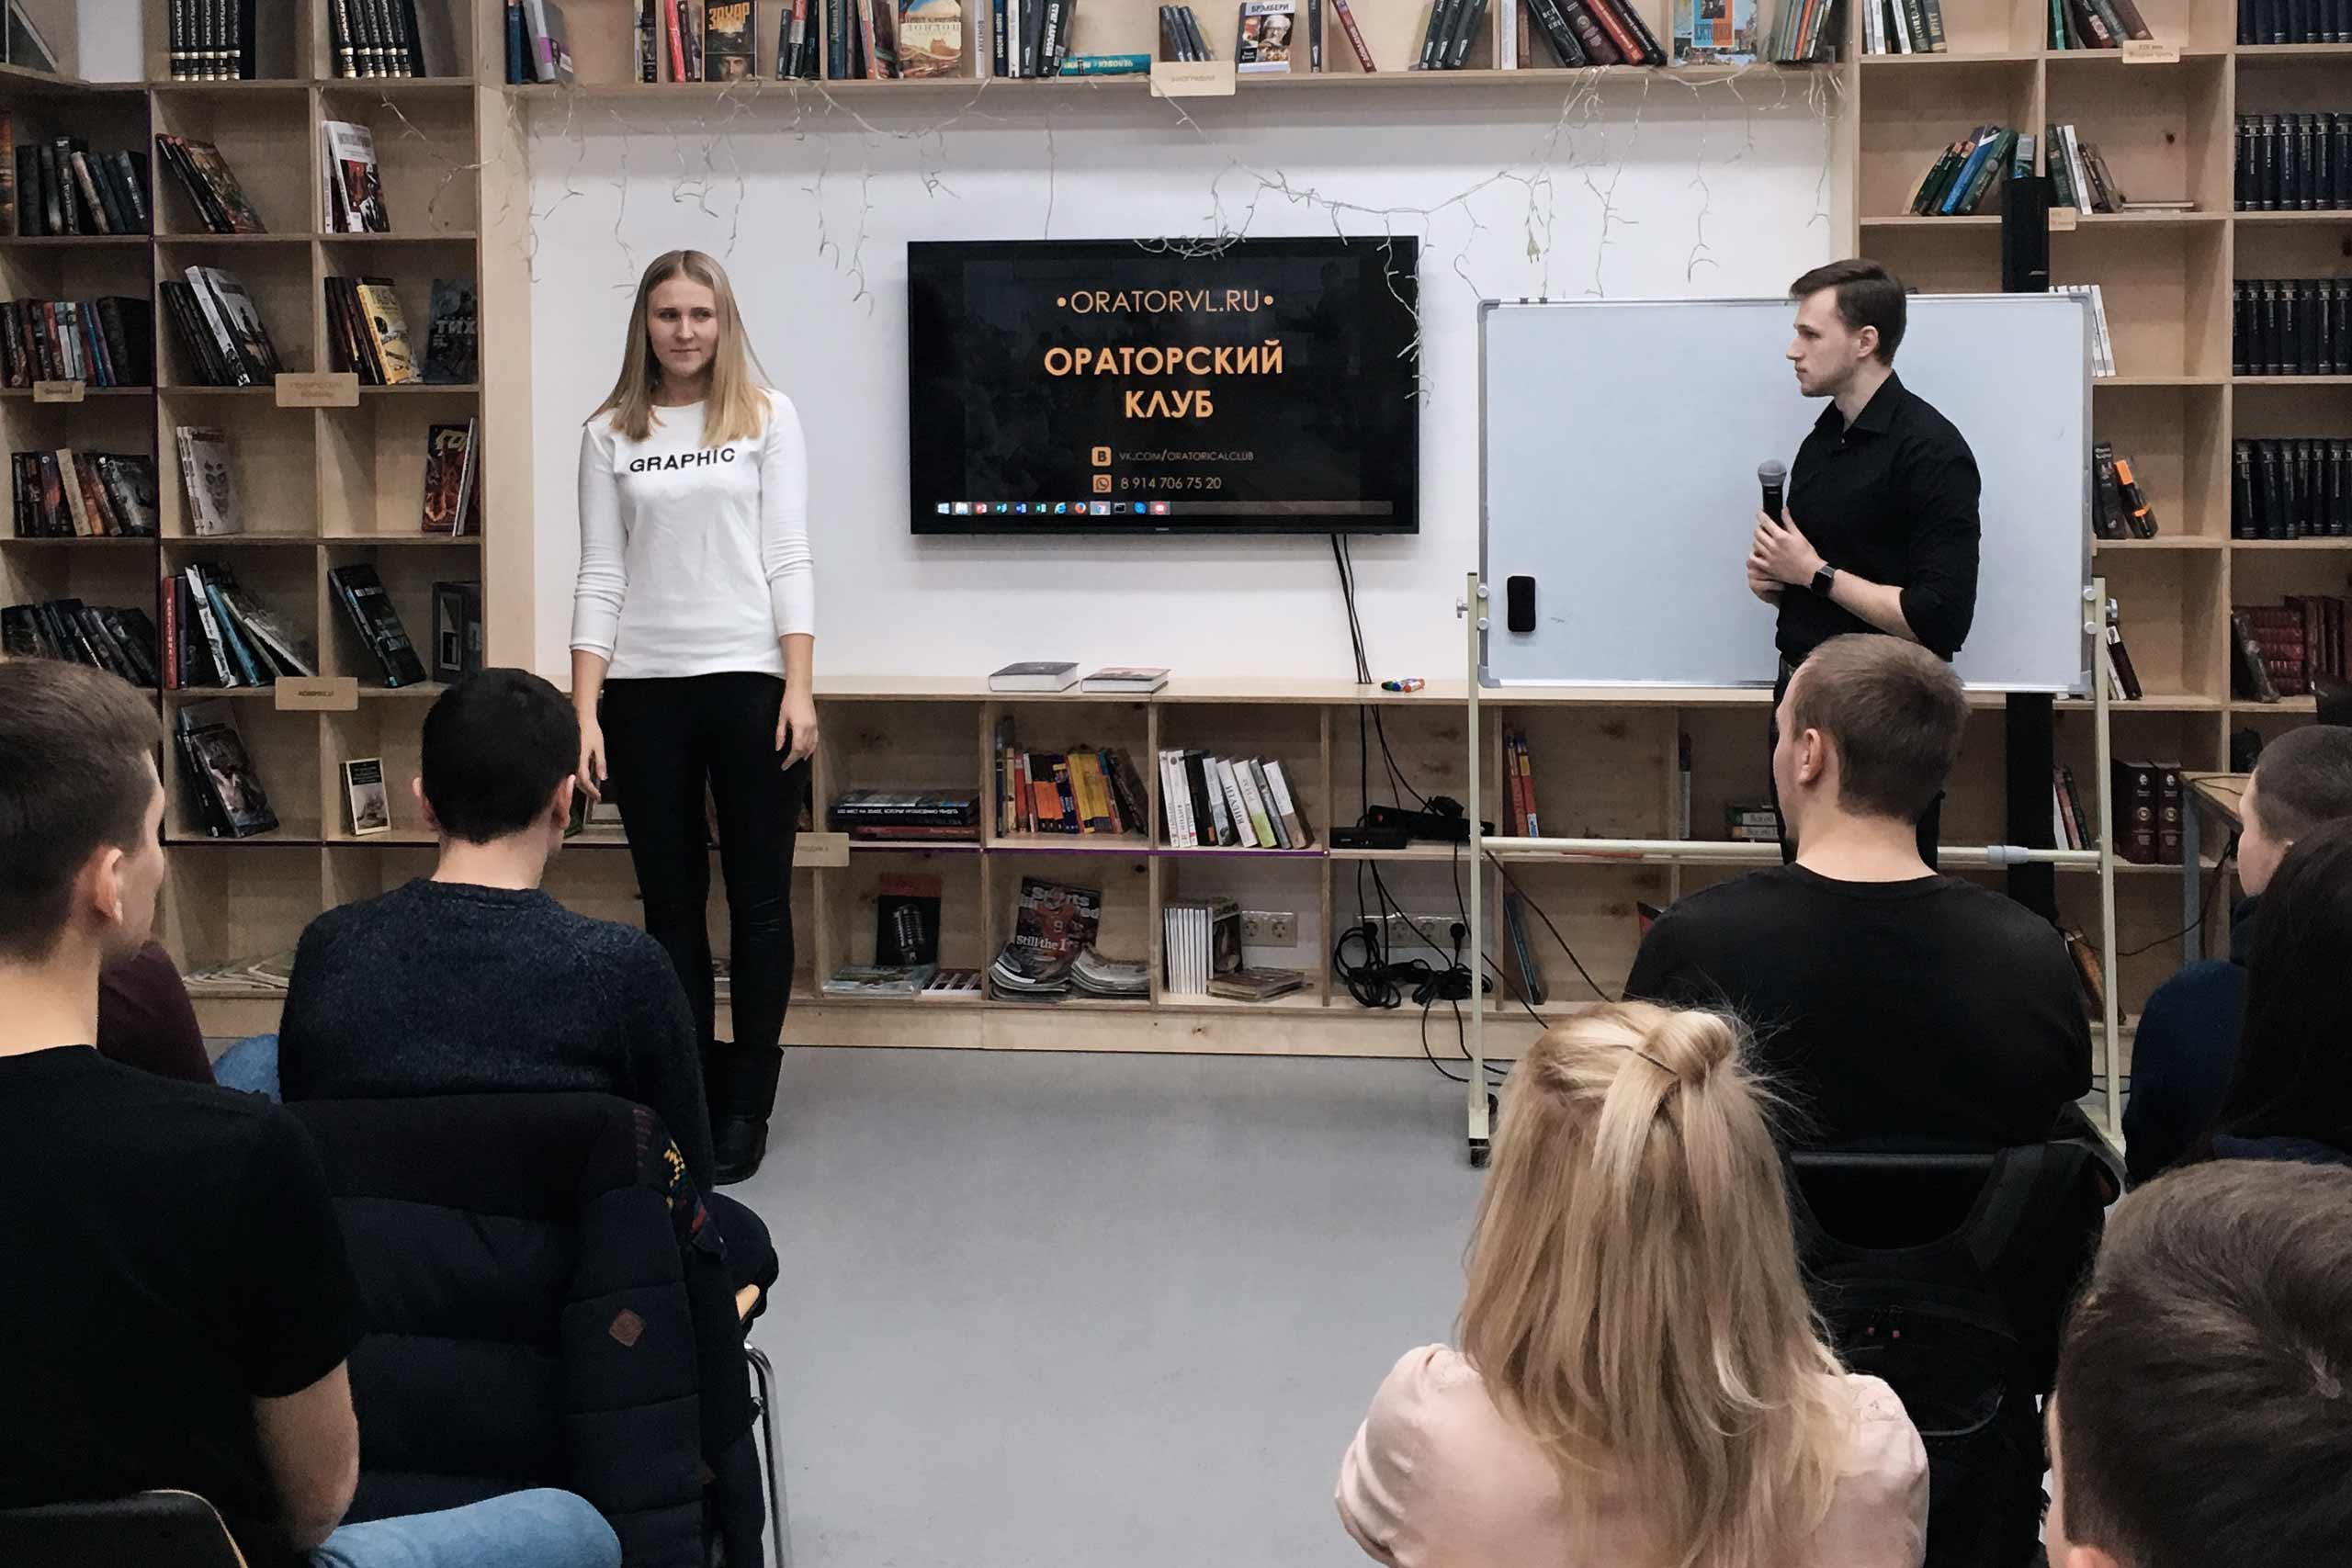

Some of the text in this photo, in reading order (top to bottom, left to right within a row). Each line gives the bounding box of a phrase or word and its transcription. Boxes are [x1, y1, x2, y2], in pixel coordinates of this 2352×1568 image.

[708, 2, 751, 30] ЗАХАР
[1071, 289, 1260, 313] ORATORVL.RU
[1044, 339, 1283, 377] ОРАТОРСКИЙ
[1125, 389, 1214, 419] КЛУБ
[629, 447, 735, 473] GRAPHIC
[1120, 477, 1222, 490] 8 914 706 75 20
